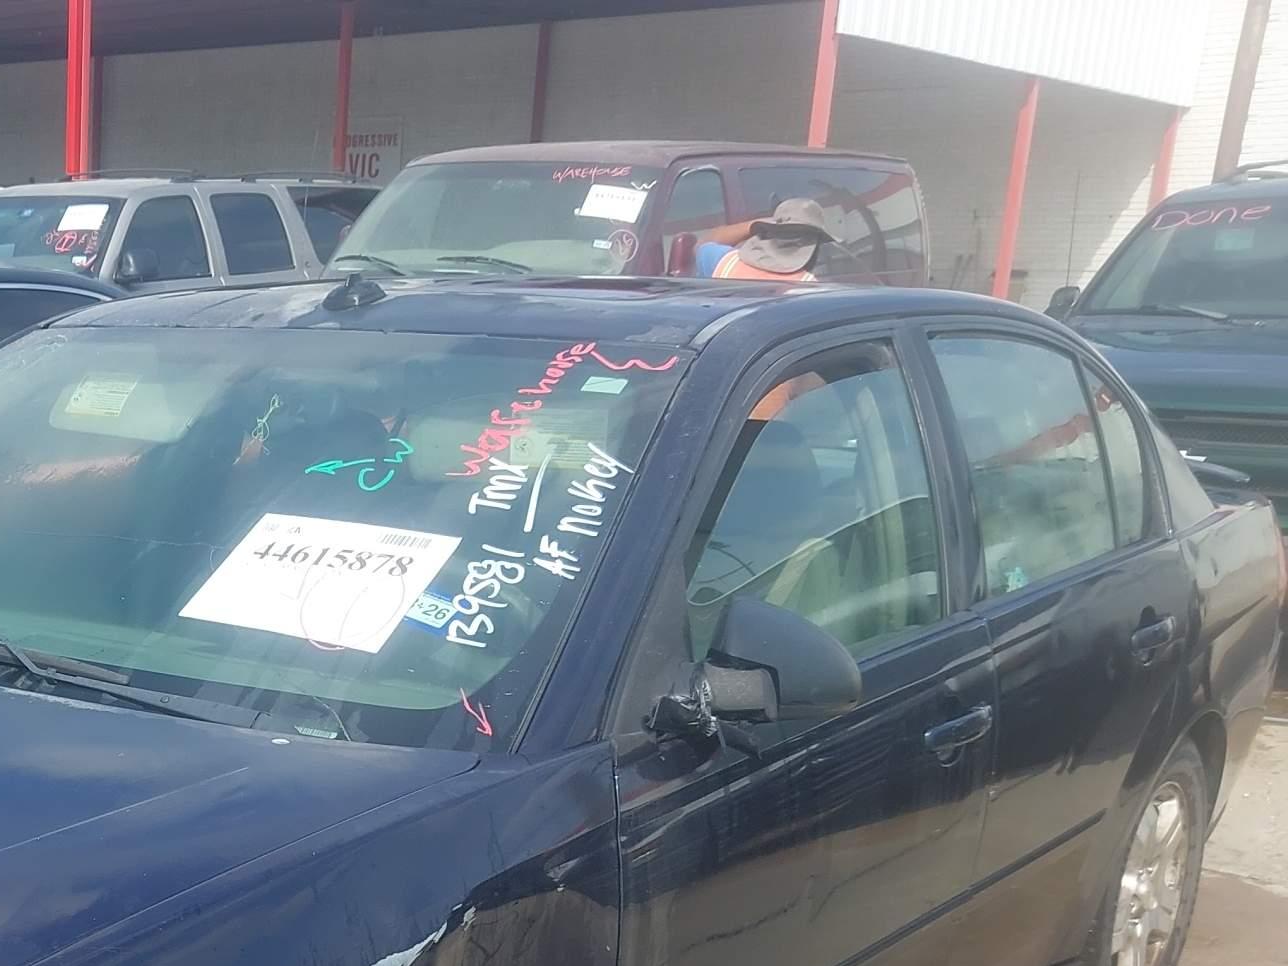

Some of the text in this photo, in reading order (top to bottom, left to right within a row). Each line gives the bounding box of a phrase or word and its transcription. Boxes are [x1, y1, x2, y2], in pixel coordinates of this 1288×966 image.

[333, 133, 399, 149] OGRESSIVE
[348, 152, 381, 179] VIC
[552, 165, 632, 183] WAREHOUSE
[252, 541, 415, 577] 44615878
